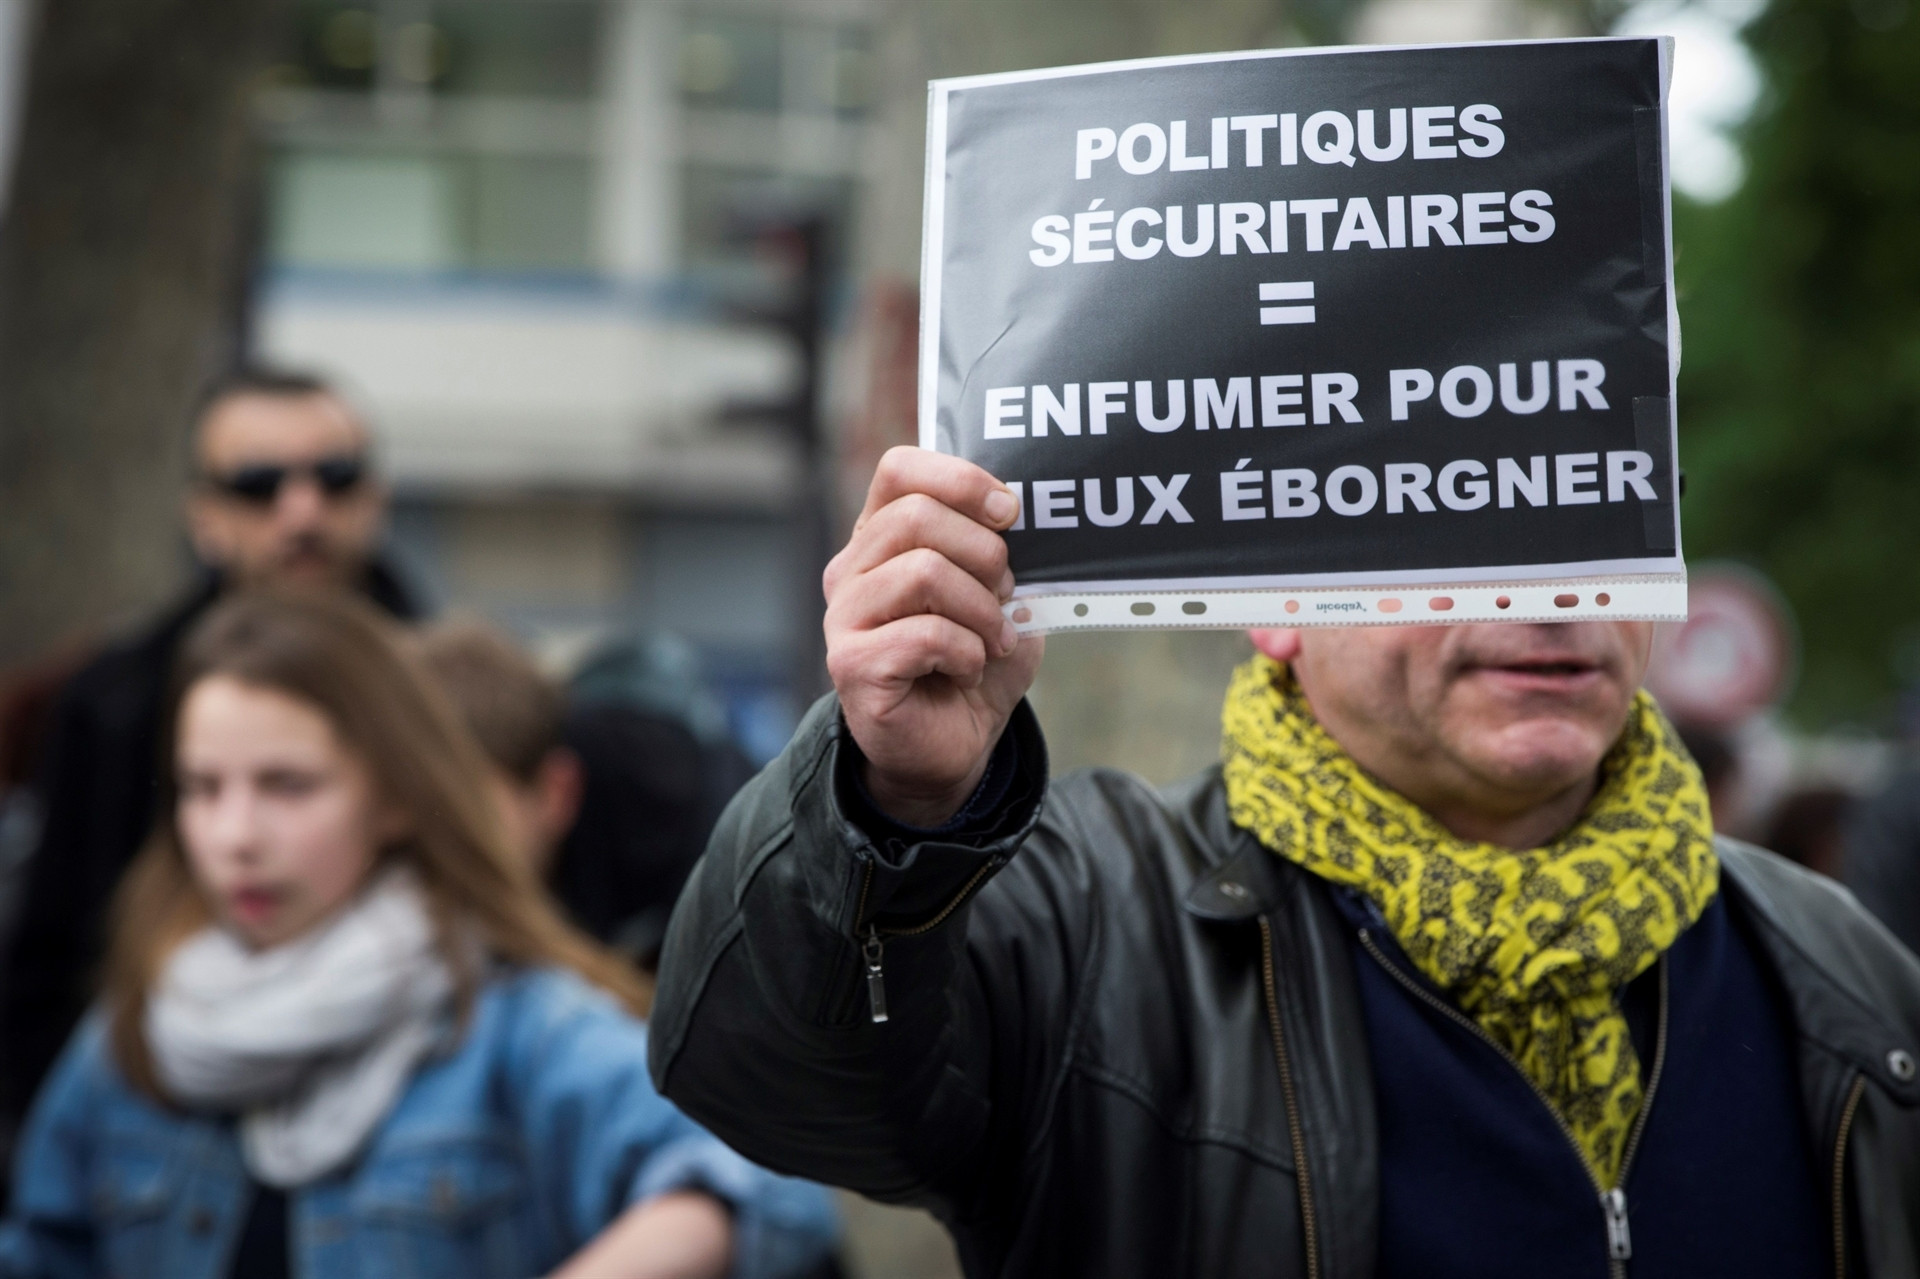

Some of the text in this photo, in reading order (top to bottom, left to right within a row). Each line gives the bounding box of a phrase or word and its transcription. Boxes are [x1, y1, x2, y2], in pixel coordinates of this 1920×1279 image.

[1075, 104, 1505, 180] POLITIQUES
[1028, 189, 1556, 268] SÉCURITAIRES
[983, 359, 1610, 440] ENFUMER POUR
[1005, 450, 1658, 531] IEUX ÉBORGNER
